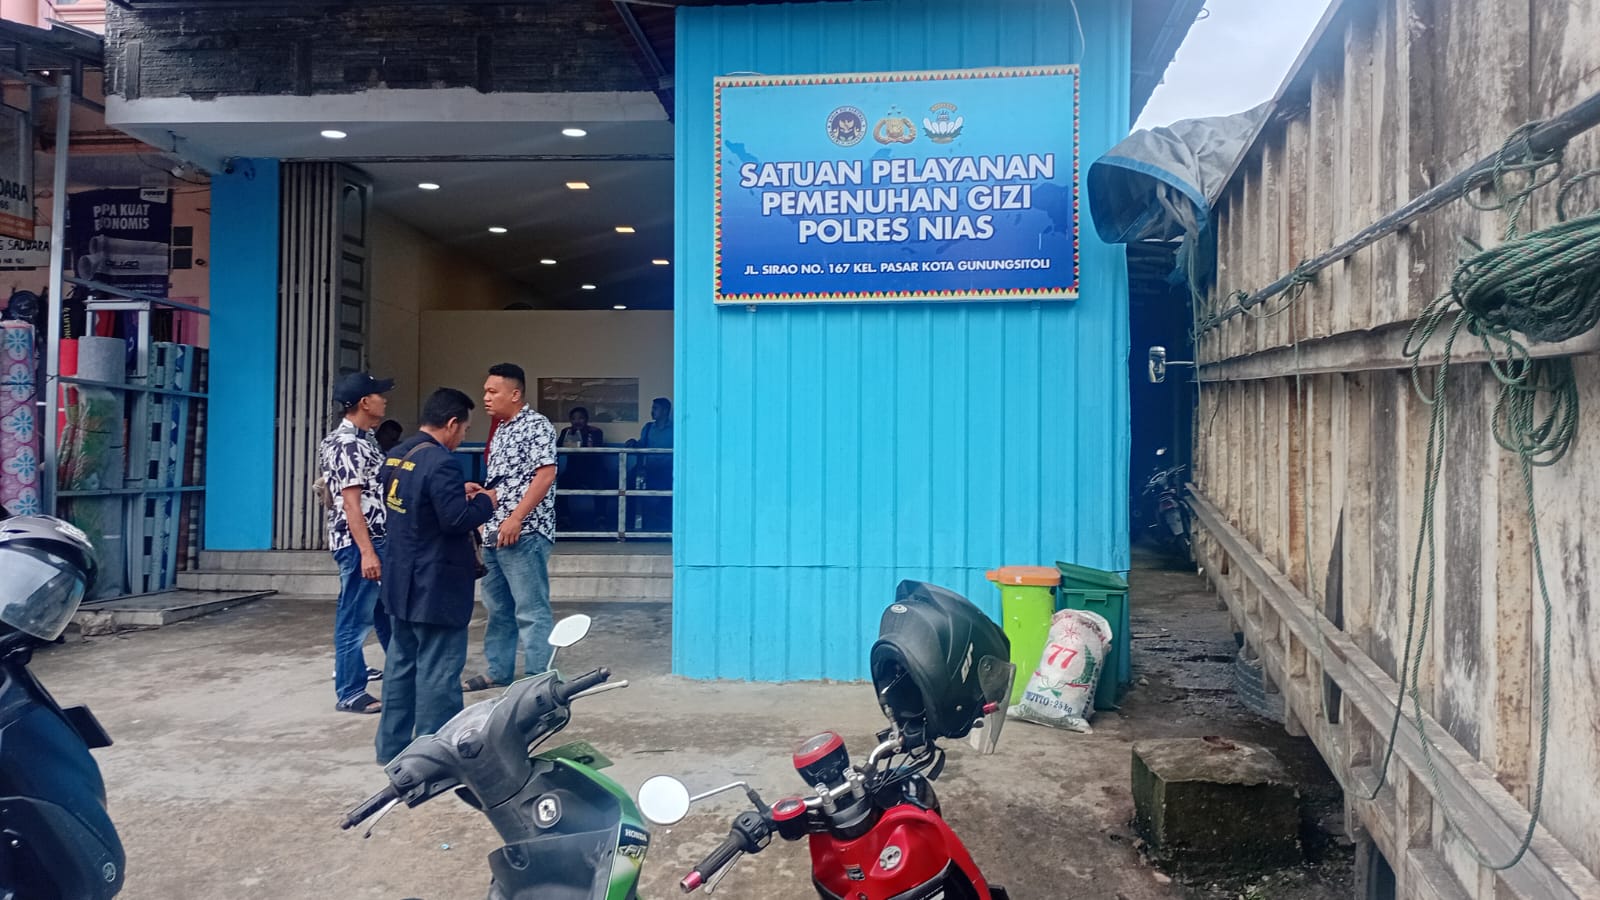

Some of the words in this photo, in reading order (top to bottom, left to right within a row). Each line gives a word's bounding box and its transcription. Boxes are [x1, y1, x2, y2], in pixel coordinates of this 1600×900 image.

[741, 161, 862, 187] SATUAN
[873, 154, 1054, 184] PELAYANAN
[120, 204, 151, 216] KUAT
[762, 188, 958, 215] PEMENUHAN
[968, 184, 1031, 210] GIZI
[799, 218, 908, 243] POLRES
[919, 215, 994, 241] NIAS
[744, 265, 759, 275] JL.
[762, 264, 798, 275] SIRAO
[801, 264, 825, 274] NO.
[829, 263, 850, 273] 167
[853, 263, 877, 273] KEL.
[880, 262, 919, 272] PASAR
[922, 261, 954, 271] KOTA
[958, 259, 1050, 270] GUNUNGSITOLI
[1047, 644, 1078, 669] 77
[624, 828, 648, 842] HONDA
